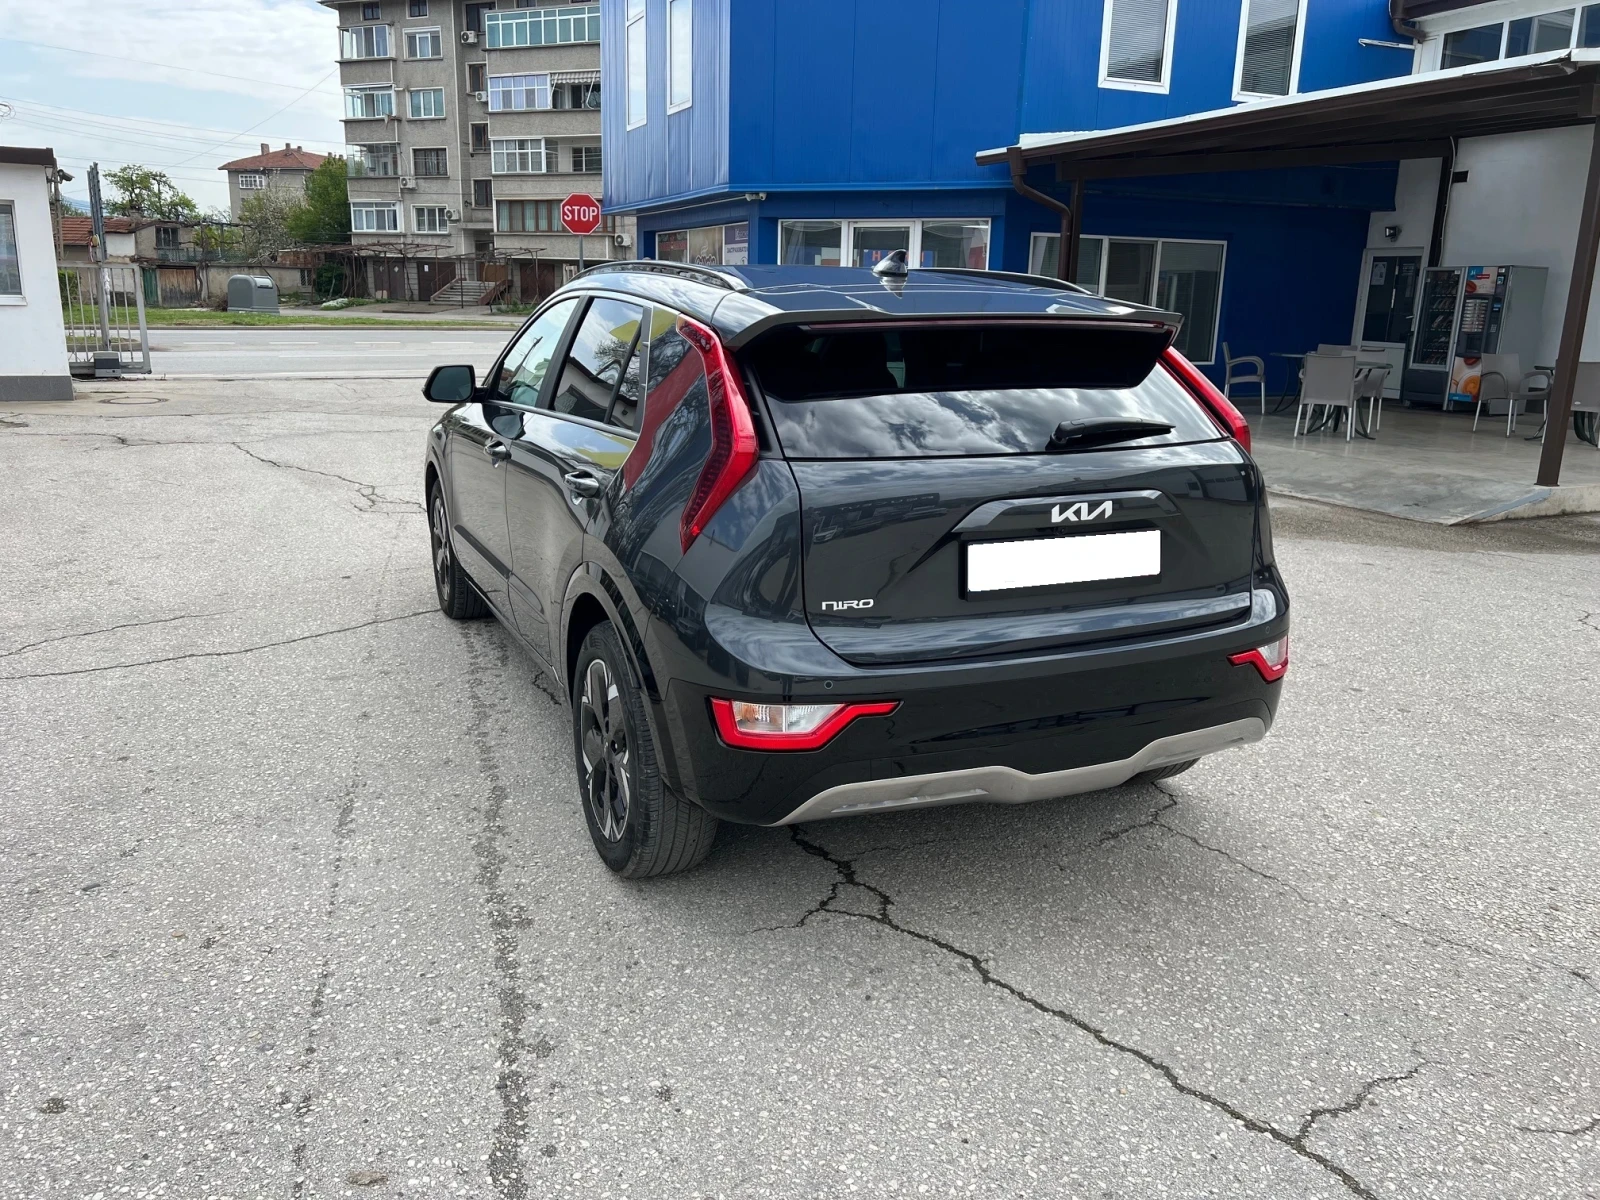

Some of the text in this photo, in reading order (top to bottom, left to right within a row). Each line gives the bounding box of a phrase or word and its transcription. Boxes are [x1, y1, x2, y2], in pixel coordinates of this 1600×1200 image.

[563, 205, 598, 221] STOP
[1051, 500, 1113, 523] KIA
[821, 598, 874, 611] NIRO
